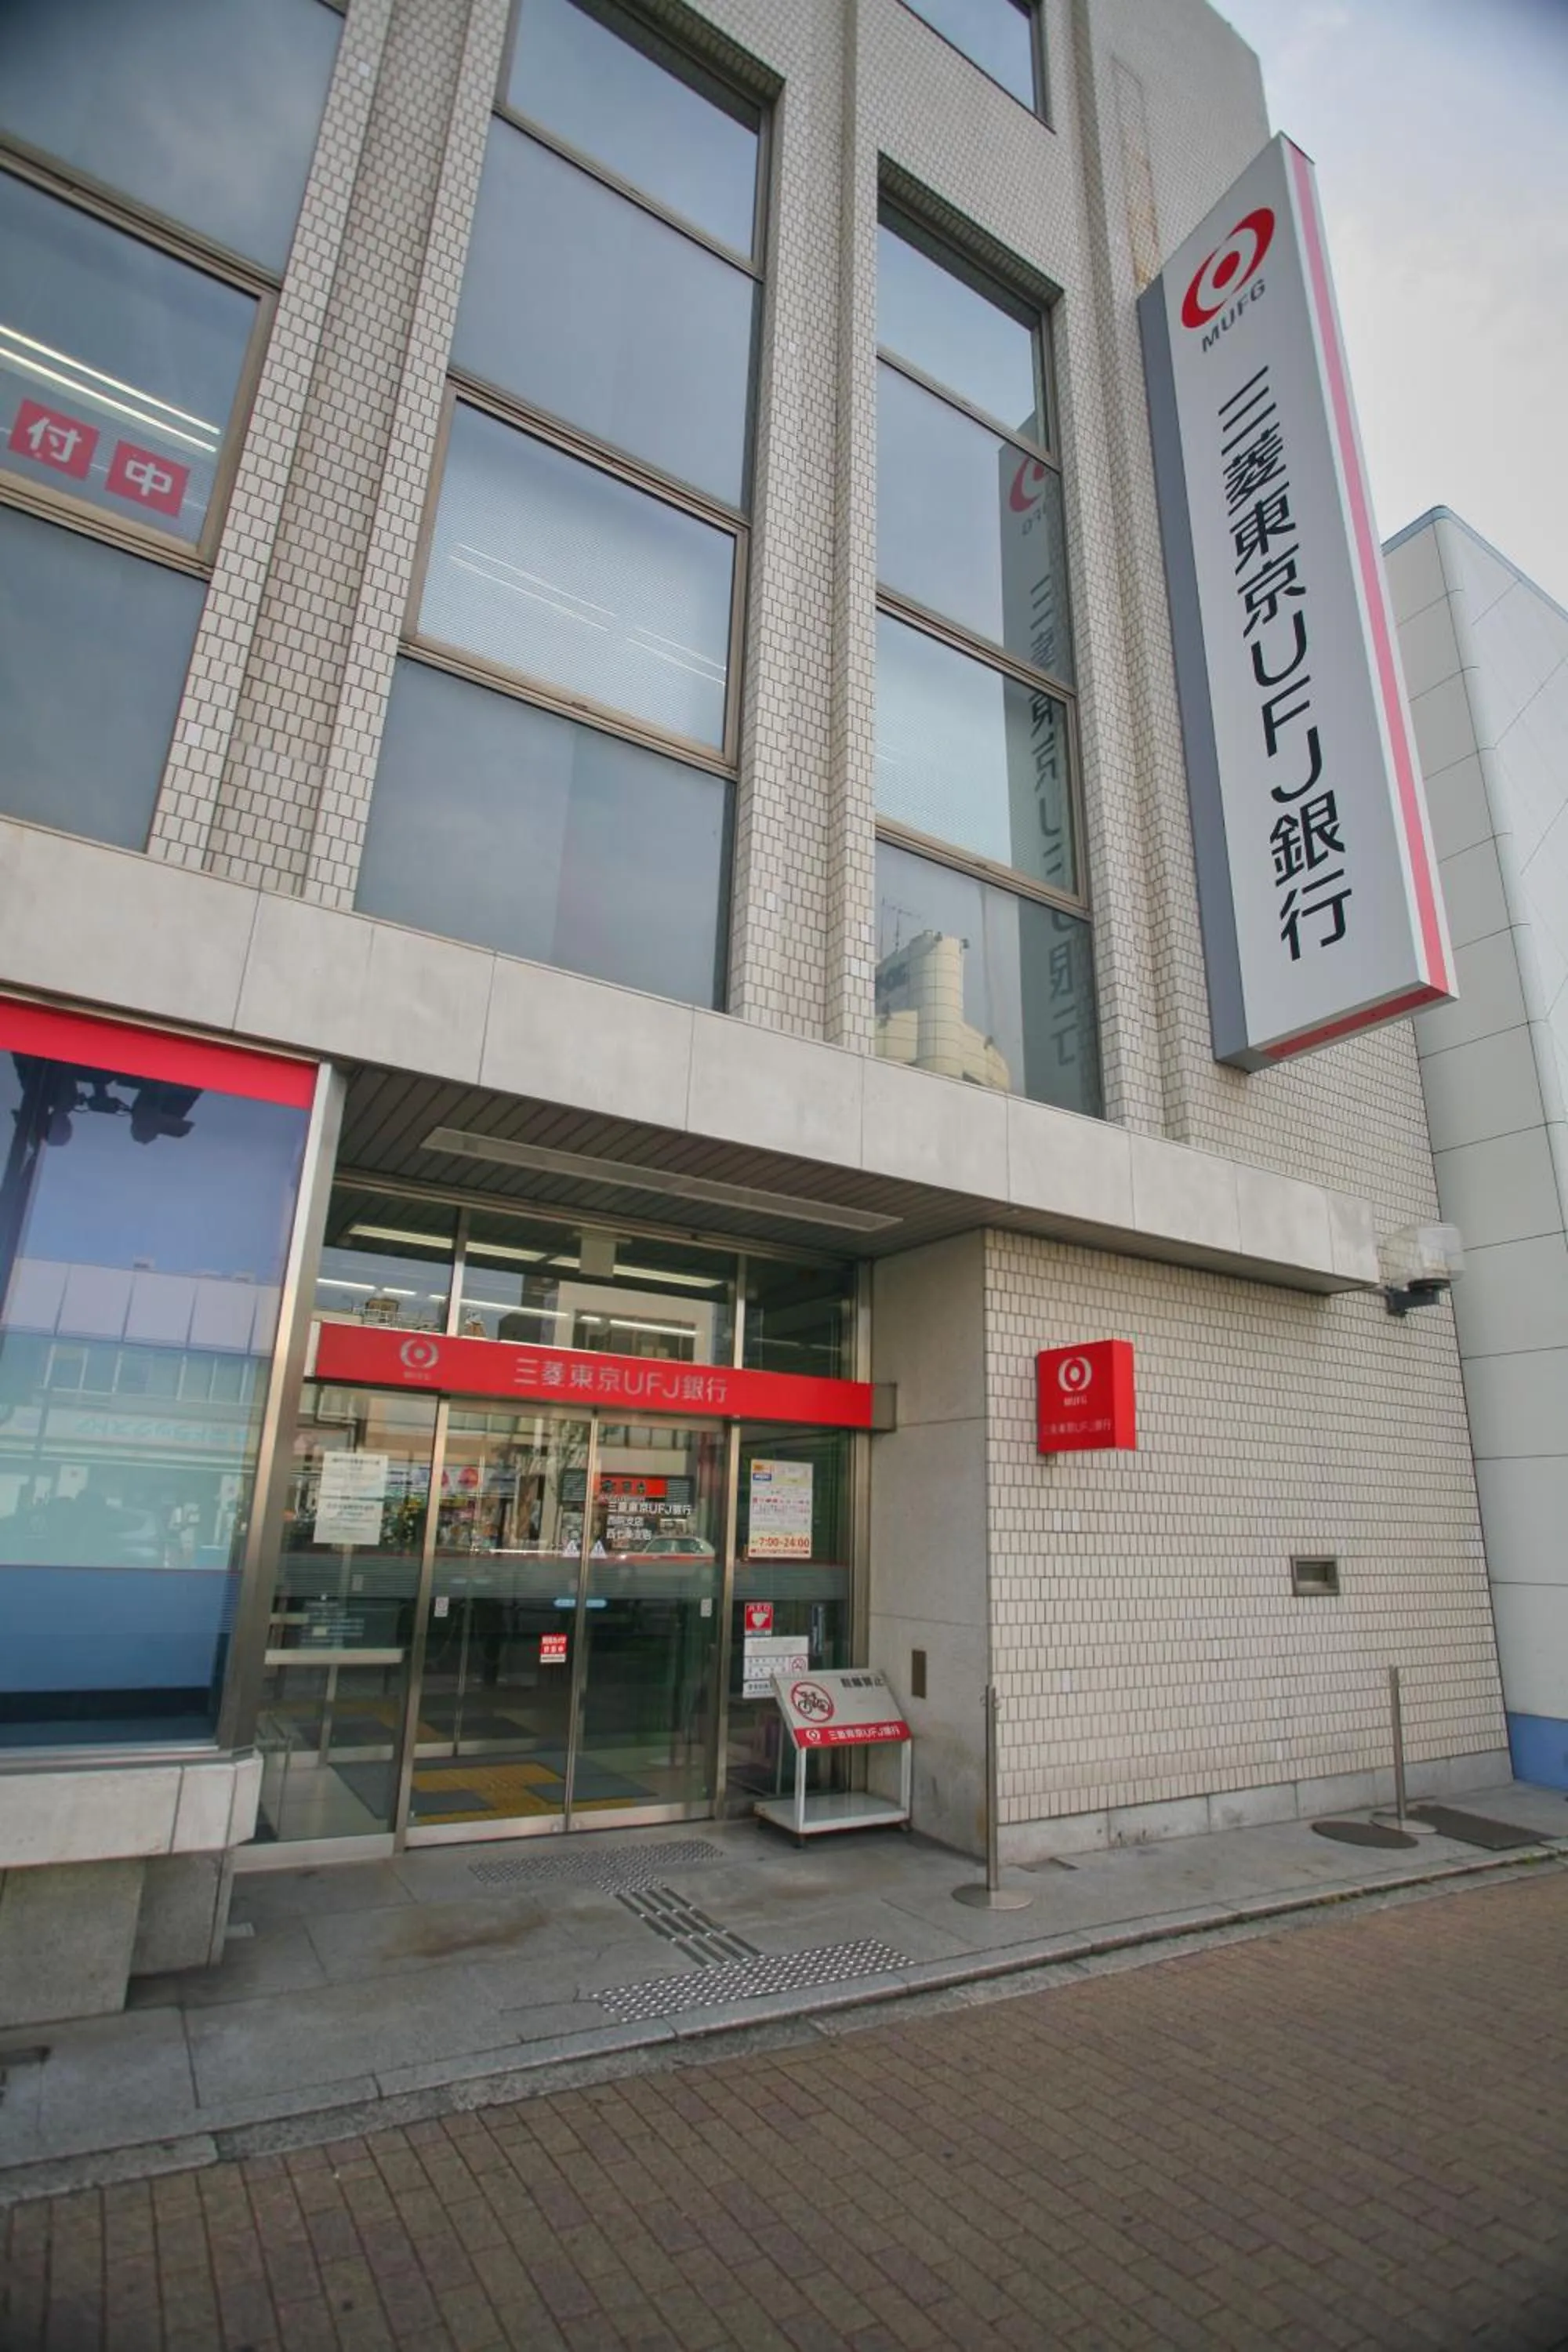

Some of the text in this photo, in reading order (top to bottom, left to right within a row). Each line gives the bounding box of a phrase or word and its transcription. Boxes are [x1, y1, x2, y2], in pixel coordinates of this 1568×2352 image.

[1201, 278, 1266, 353] MUFG
[1218, 365, 1352, 961] 三菱東京UFJ銀行
[514, 1357, 728, 1404] 三菱東京UFJ銀行
